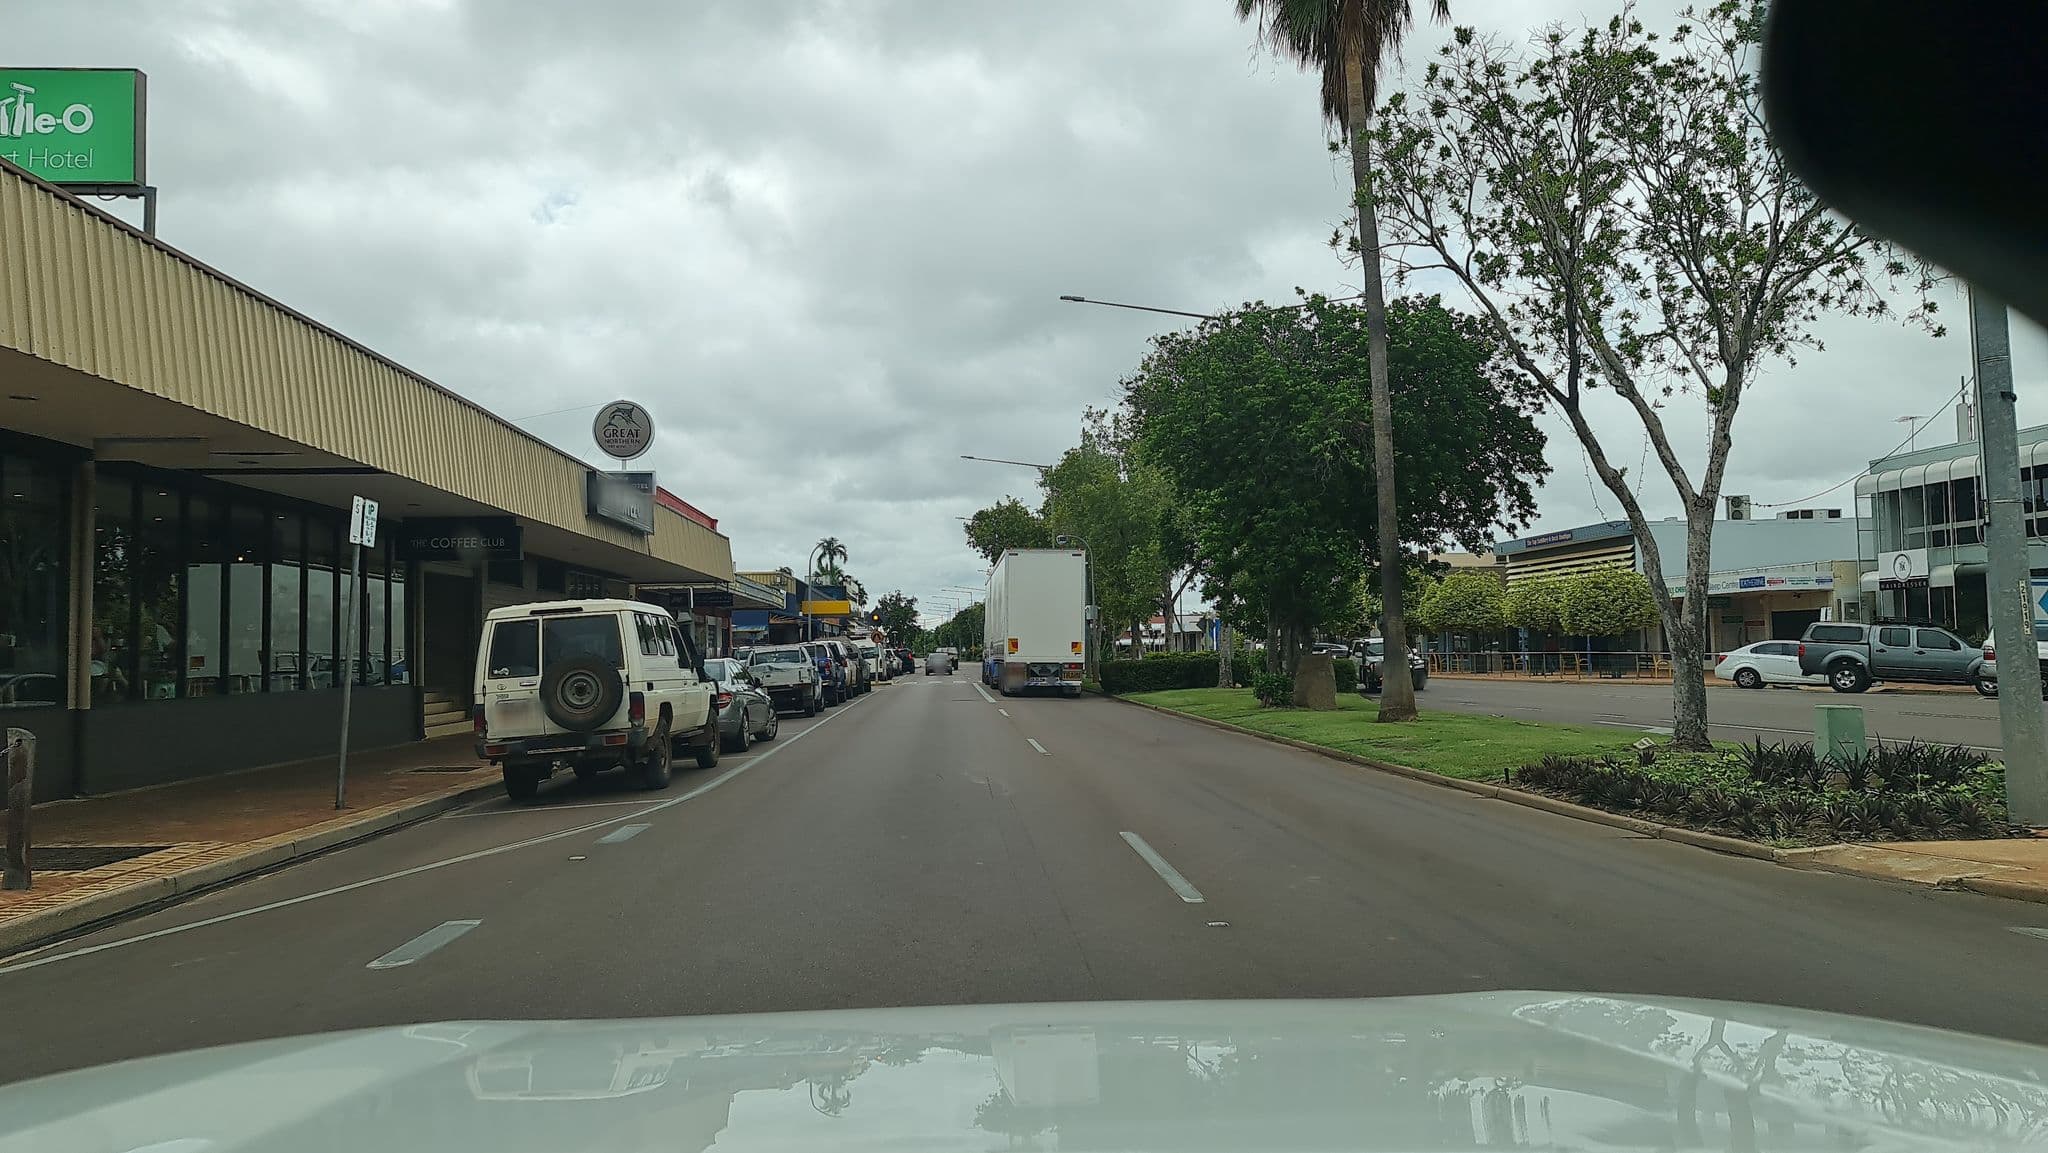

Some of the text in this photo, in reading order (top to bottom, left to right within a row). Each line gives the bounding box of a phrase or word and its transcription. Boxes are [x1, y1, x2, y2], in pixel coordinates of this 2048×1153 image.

[29, 148, 93, 168] Hotel
[603, 428, 641, 438] GREAT
[430, 537, 478, 549] COFFEE
[480, 537, 505, 547] CLUB
